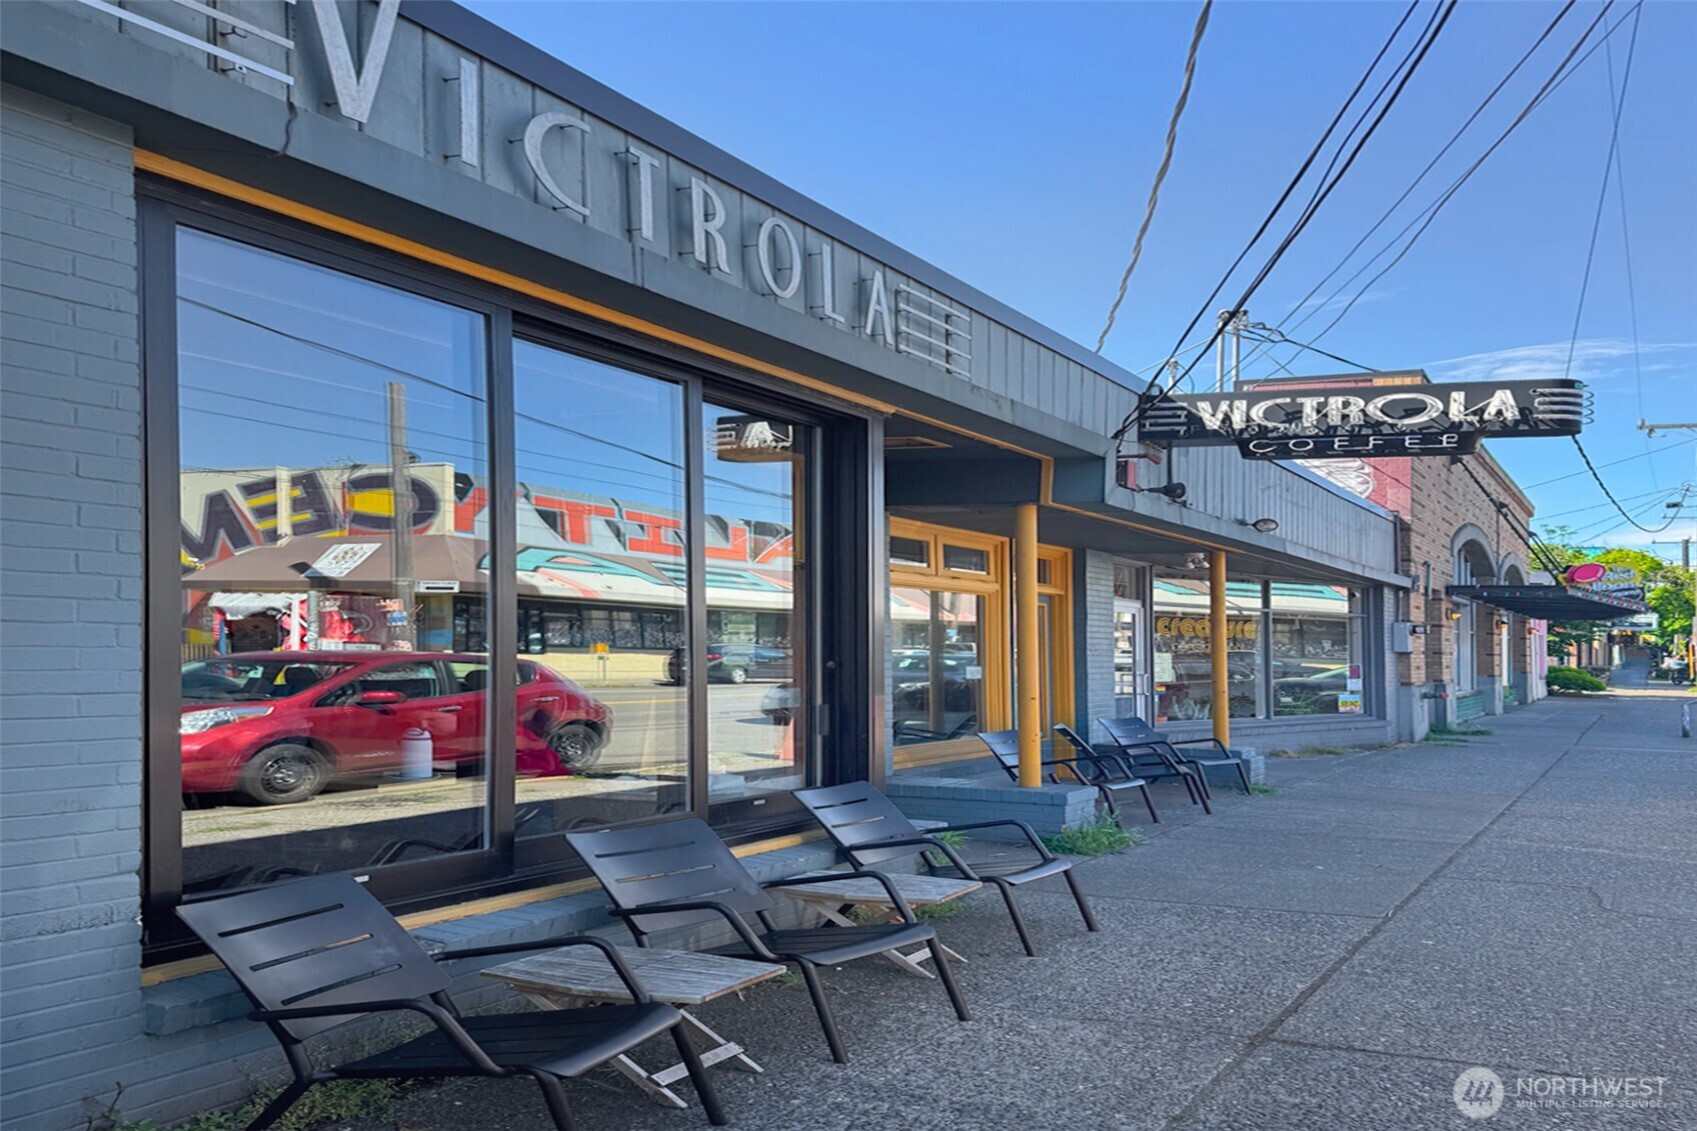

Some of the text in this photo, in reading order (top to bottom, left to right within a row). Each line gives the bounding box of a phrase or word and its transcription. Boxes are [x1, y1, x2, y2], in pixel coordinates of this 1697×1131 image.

[312, 0, 894, 346] VICTROLA
[1196, 389, 1521, 430] VICTROLA
[1156, 617, 1257, 639] creaure
